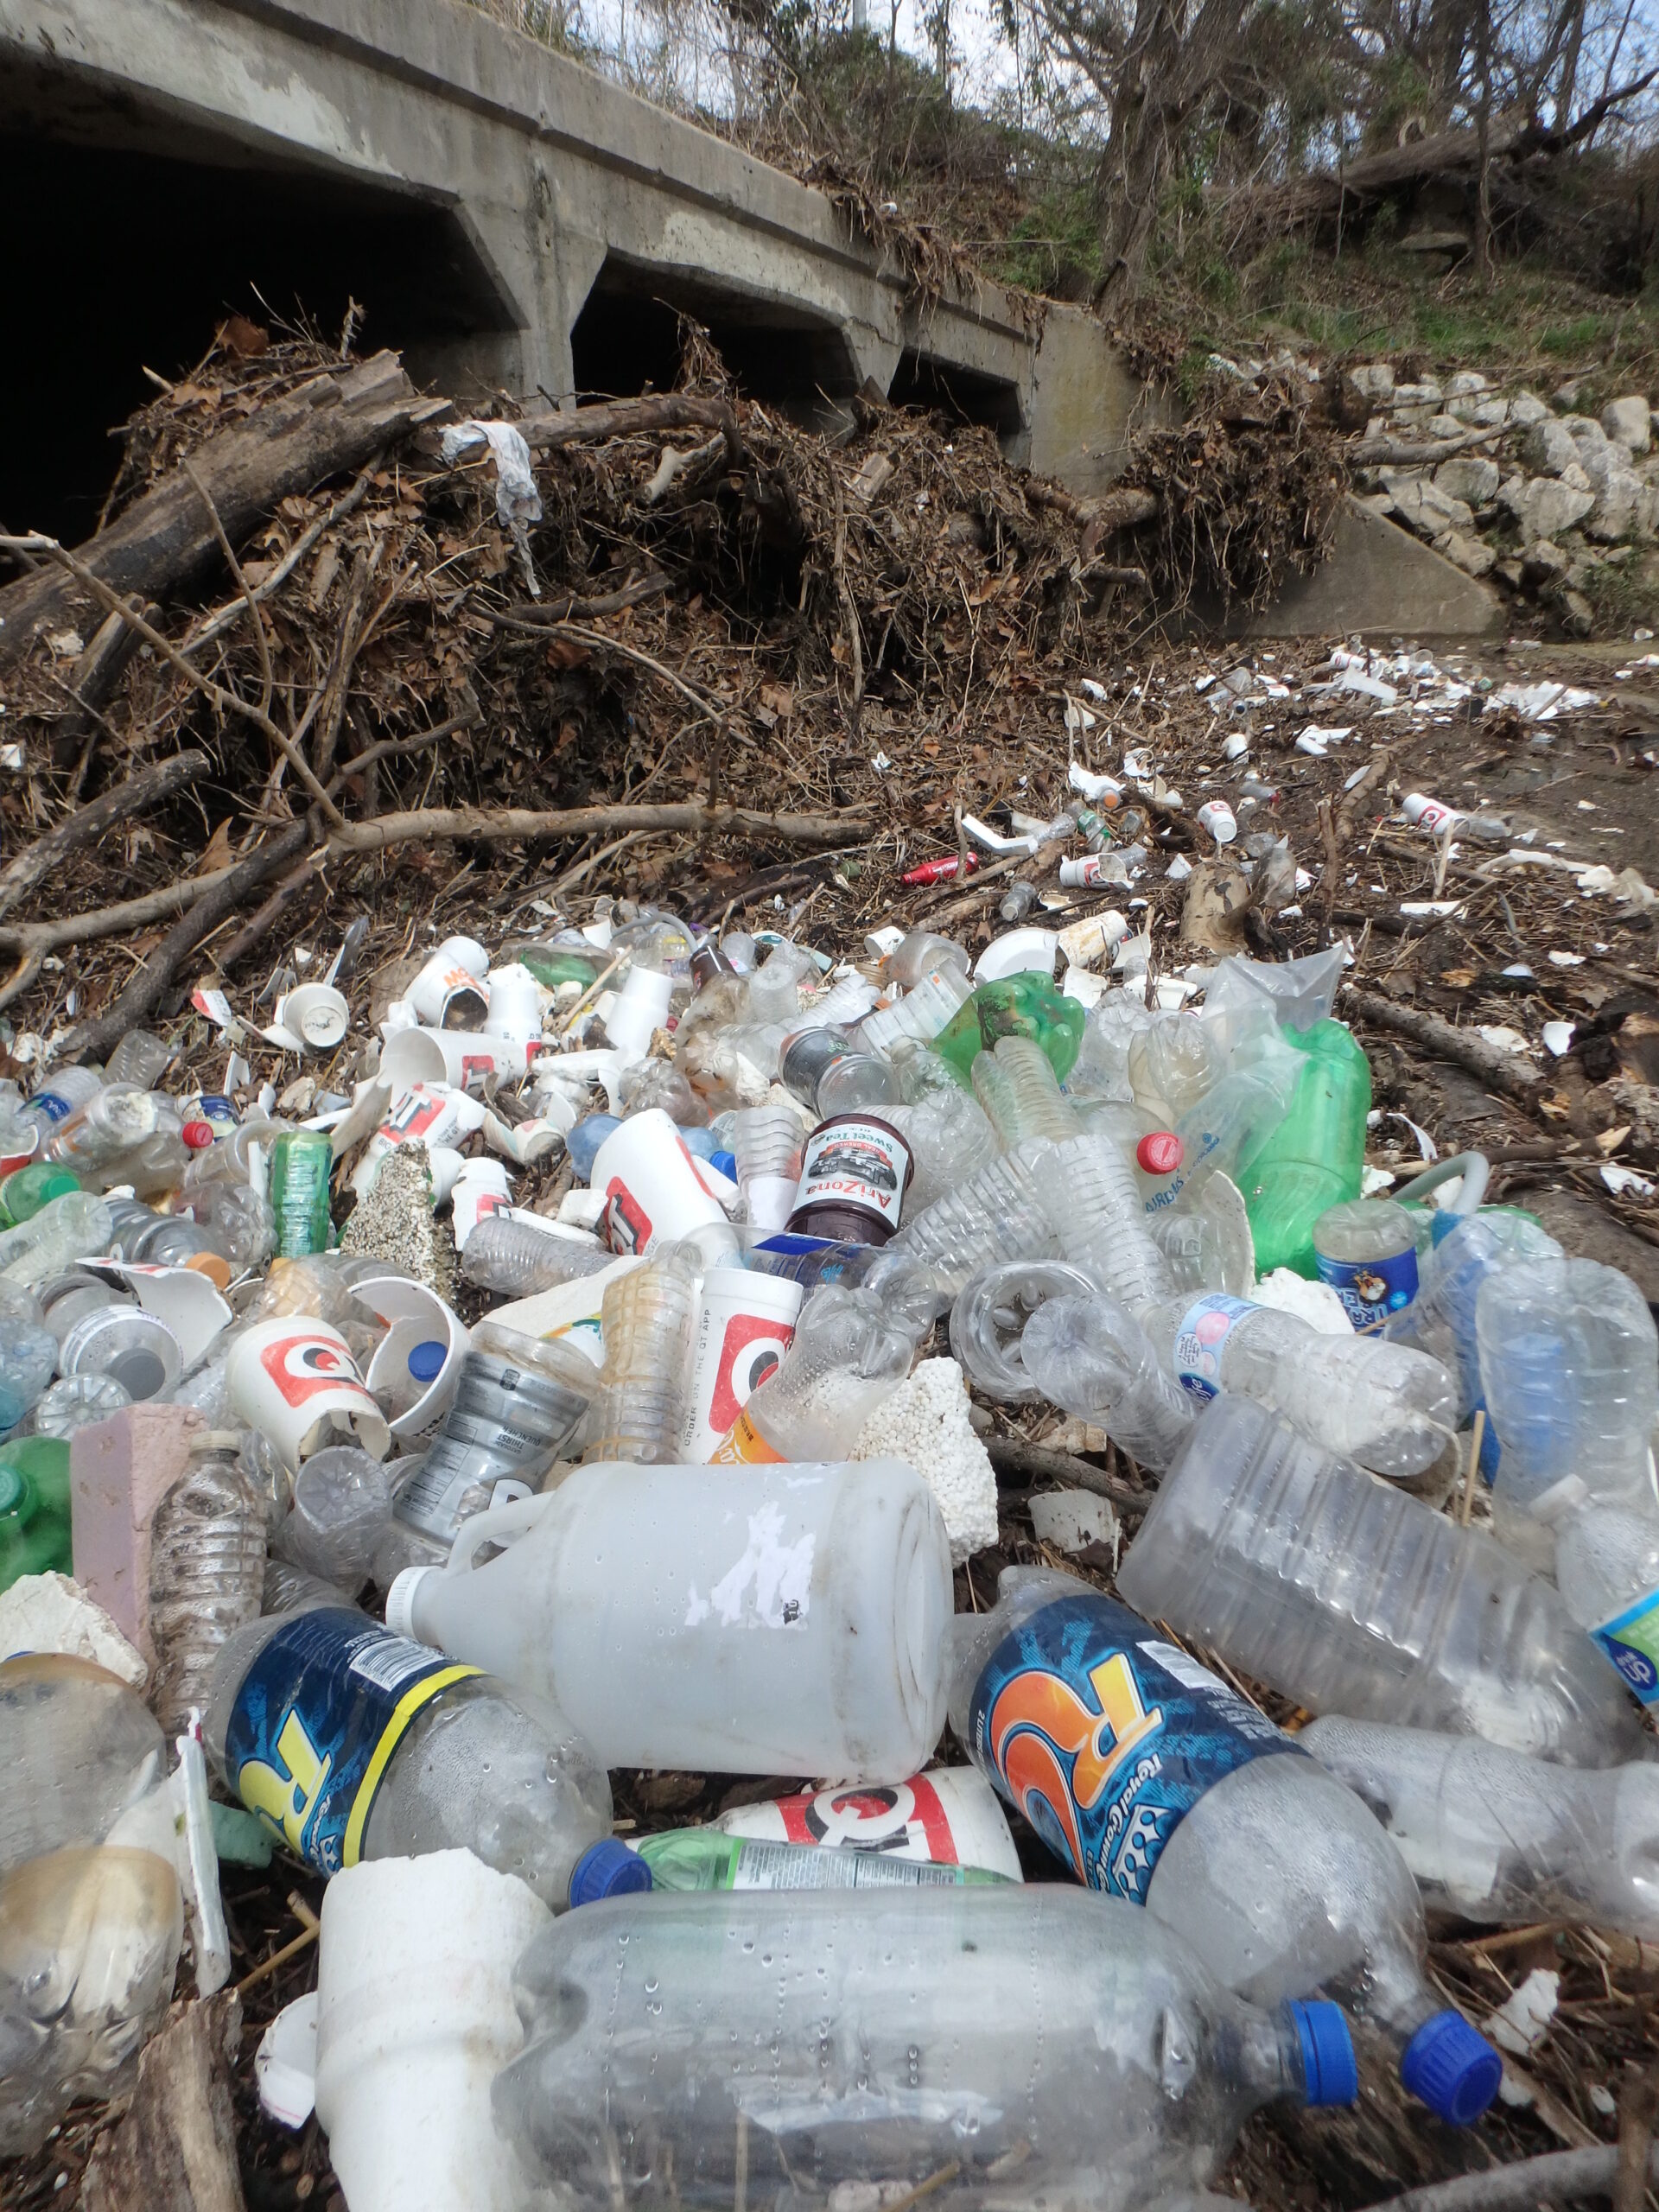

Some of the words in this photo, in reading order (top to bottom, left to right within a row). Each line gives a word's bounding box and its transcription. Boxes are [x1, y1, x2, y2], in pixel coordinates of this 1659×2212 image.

[825, 1132, 851, 1142] Tea
[852, 1132, 893, 1154] Sweet
[805, 1179, 893, 1210] AriZona
[703, 1309, 712, 1332] APP
[699, 1335, 708, 1351] QT
[696, 1355, 705, 1376] THE
[496, 1433, 526, 1450] THIRST
[502, 1425, 542, 1446] QUENCHER
[1624, 1660, 1651, 1684] up
[978, 1709, 986, 1719] 2
[1121, 1752, 1164, 1816] Royal
